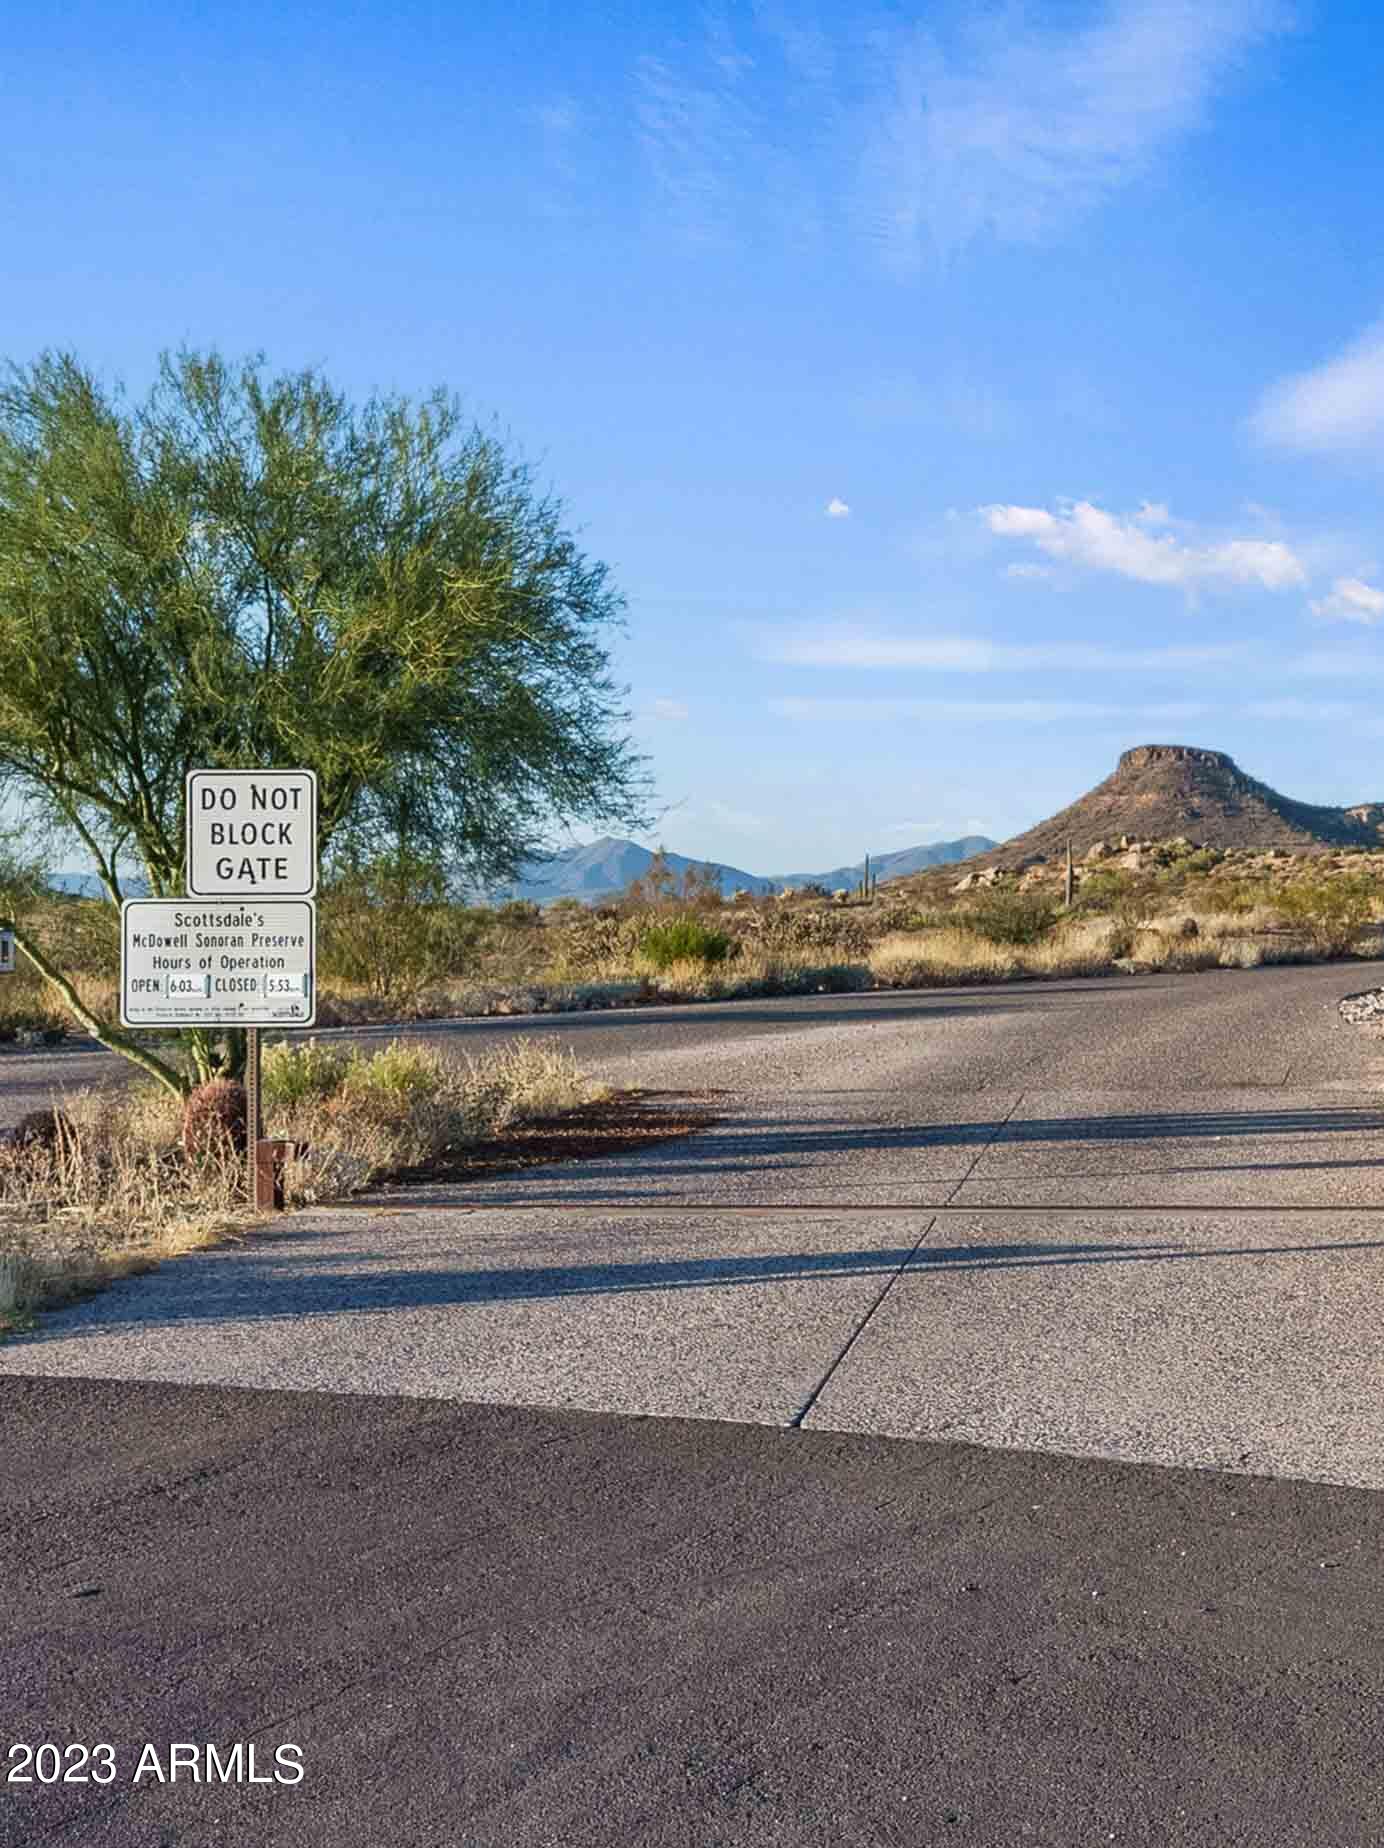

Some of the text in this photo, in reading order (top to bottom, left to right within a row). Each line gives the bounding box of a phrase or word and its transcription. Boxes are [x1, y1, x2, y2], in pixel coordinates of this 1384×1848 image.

[201, 787, 302, 811] DO NOT
[210, 822, 293, 845] BLOCK
[215, 857, 288, 880] GATE
[174, 911, 264, 928] Scottsdale's
[132, 932, 304, 948] McDowell Sonoran Preserve
[152, 956, 285, 973] Hours of Operation
[131, 978, 160, 993] OPEN
[215, 978, 257, 993] CLOSED
